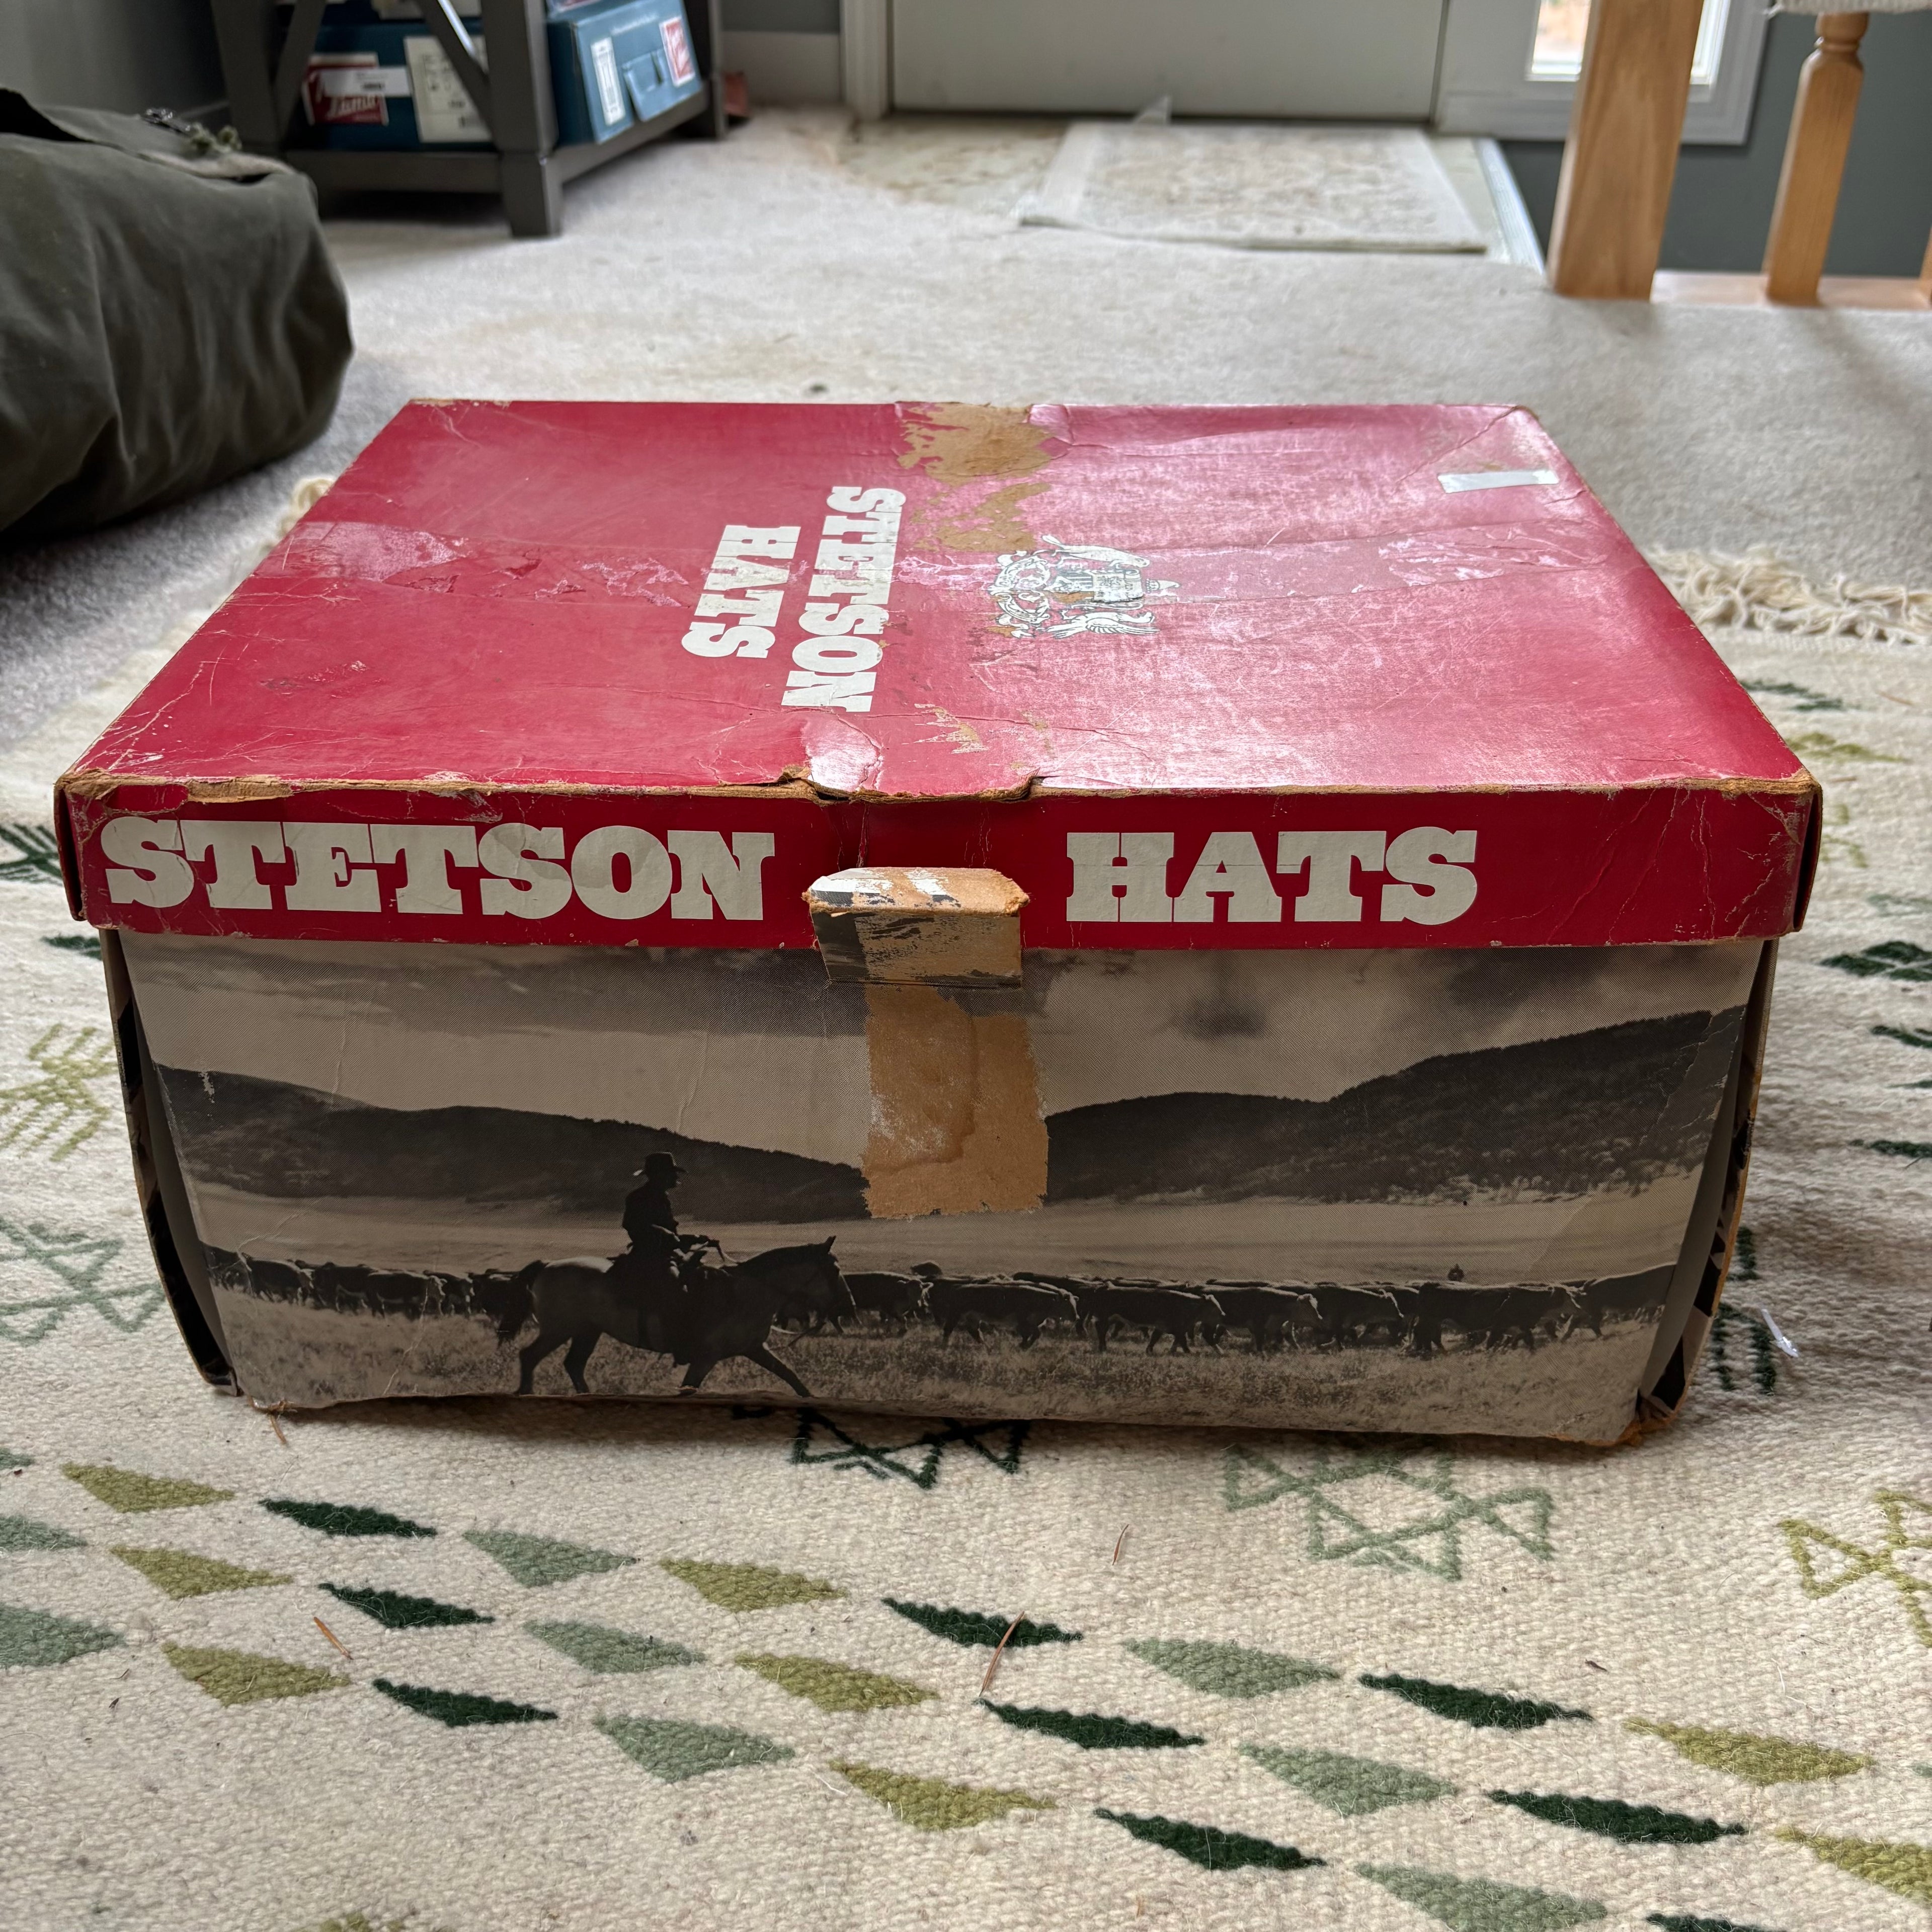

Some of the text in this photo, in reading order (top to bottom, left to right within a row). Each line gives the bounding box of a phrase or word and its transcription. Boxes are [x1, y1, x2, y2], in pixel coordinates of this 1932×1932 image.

[681, 525, 801, 658] HATS
[781, 486, 906, 712] STETSON
[101, 817, 1478, 925] STETSON HATS
